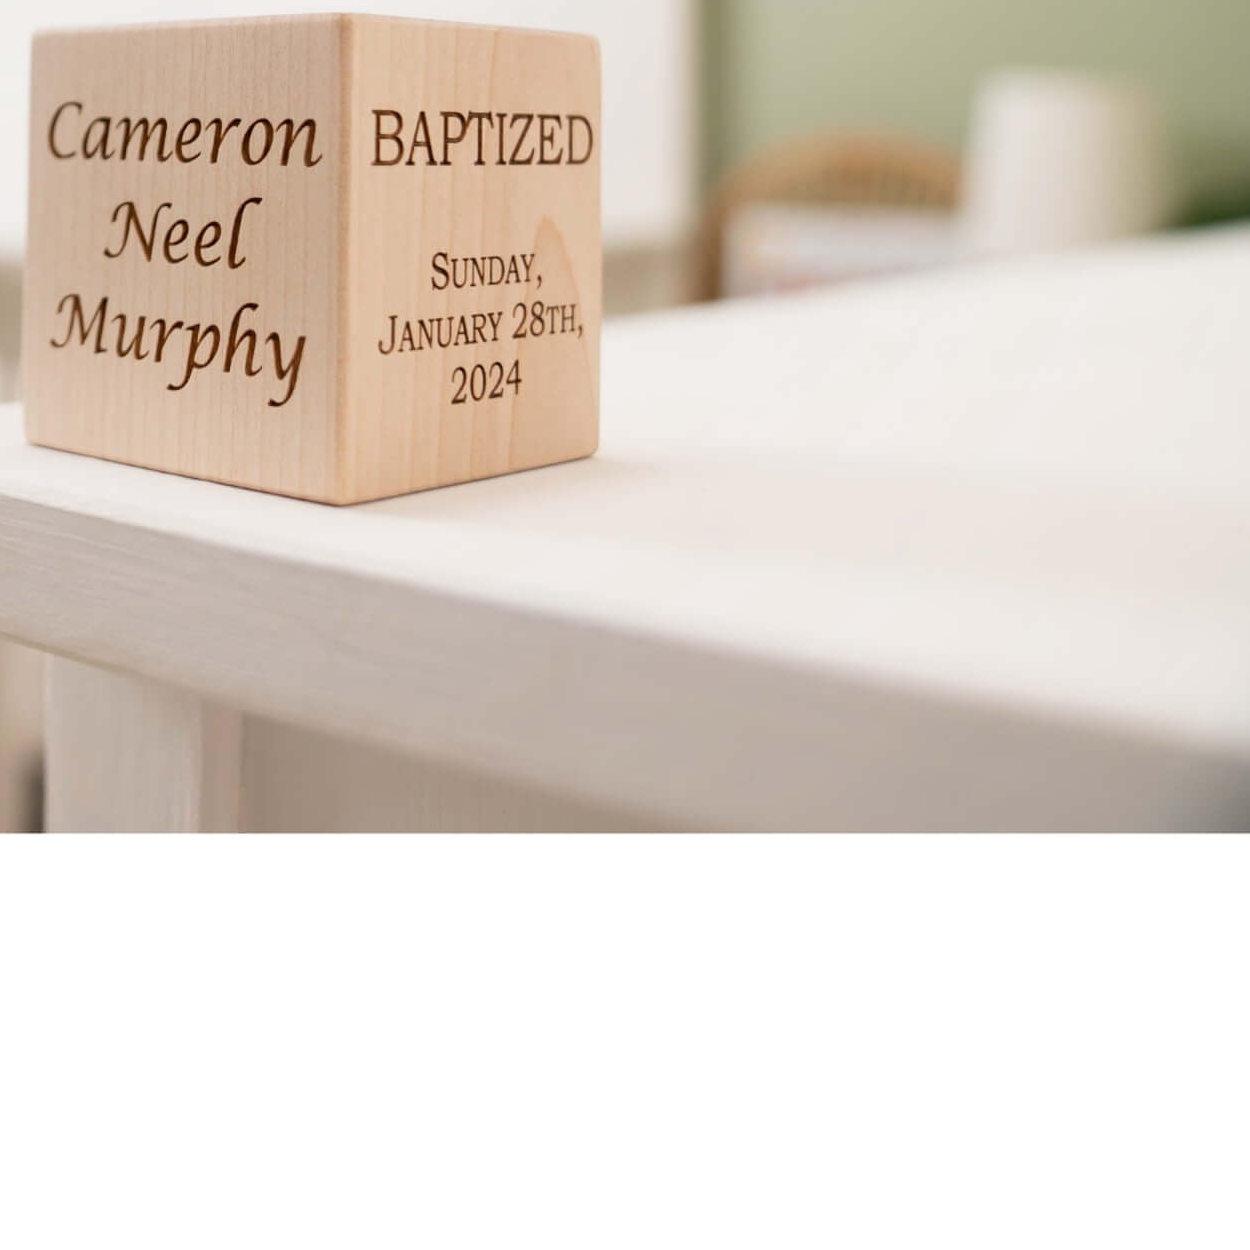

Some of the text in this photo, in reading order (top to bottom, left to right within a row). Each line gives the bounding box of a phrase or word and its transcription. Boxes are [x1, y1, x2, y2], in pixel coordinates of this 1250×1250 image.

[47, 100, 324, 168] Cameron
[370, 108, 595, 167] BAPTIZED
[102, 196, 263, 270] Neel
[430, 250, 543, 291] SUNDAY,
[48, 292, 307, 408] Murphy
[377, 299, 584, 356] JANUARY 28TH,
[450, 358, 524, 406] 2024
